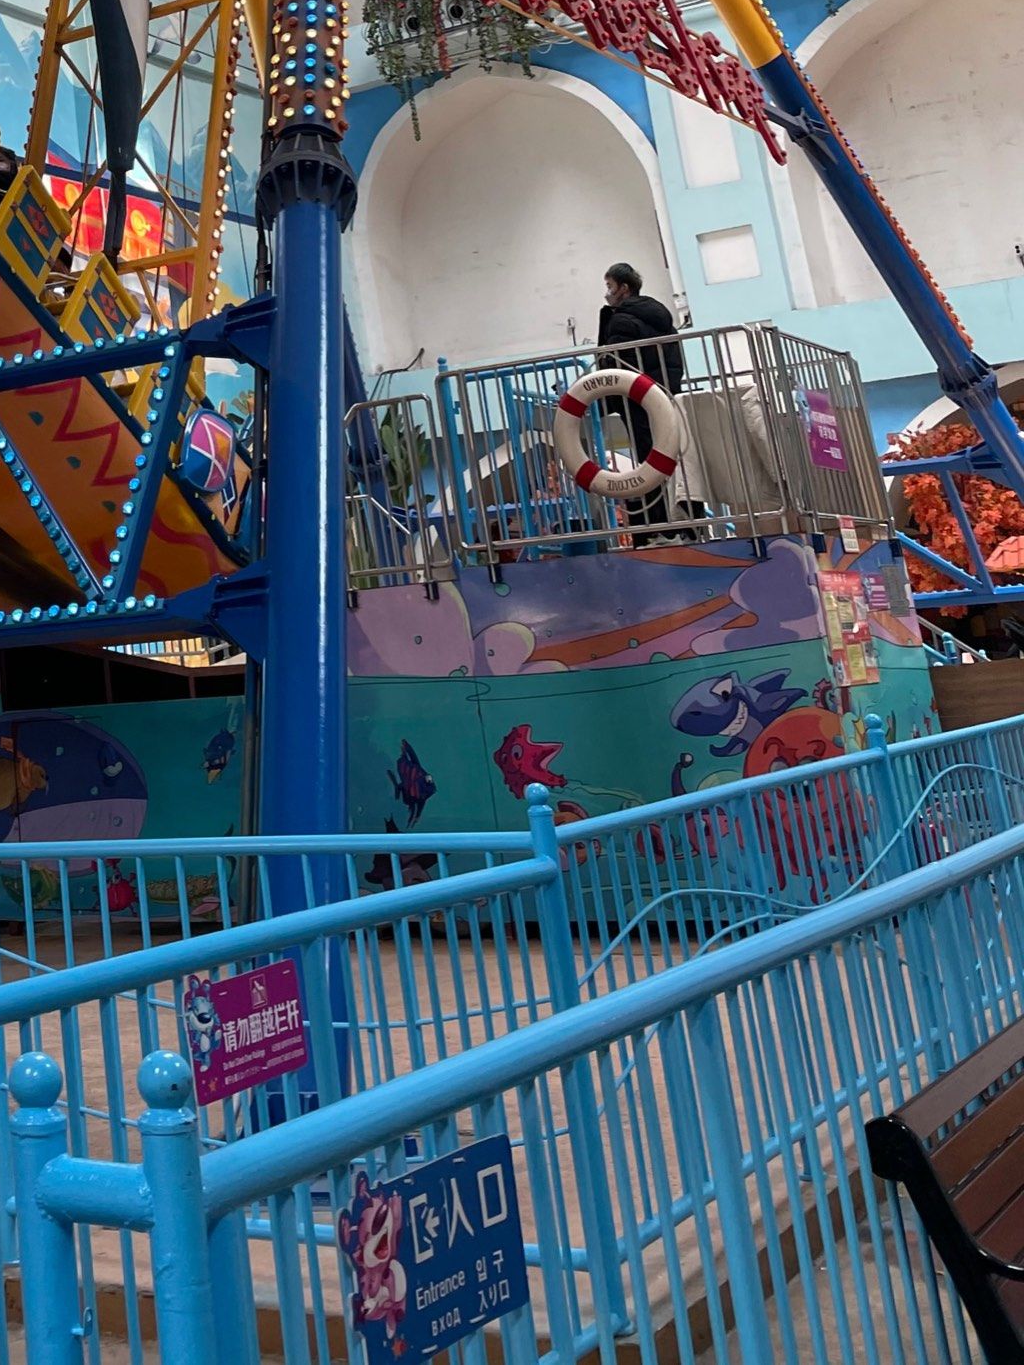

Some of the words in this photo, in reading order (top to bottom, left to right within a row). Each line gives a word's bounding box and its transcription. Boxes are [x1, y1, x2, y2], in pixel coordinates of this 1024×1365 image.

[583, 375, 620, 392] ABOARD
[607, 475, 645, 492] WELCOME
[222, 999, 300, 1053] 请勿翻越栏杆
[448, 1163, 508, 1249] 入口
[416, 1270, 466, 1310] Entrance
